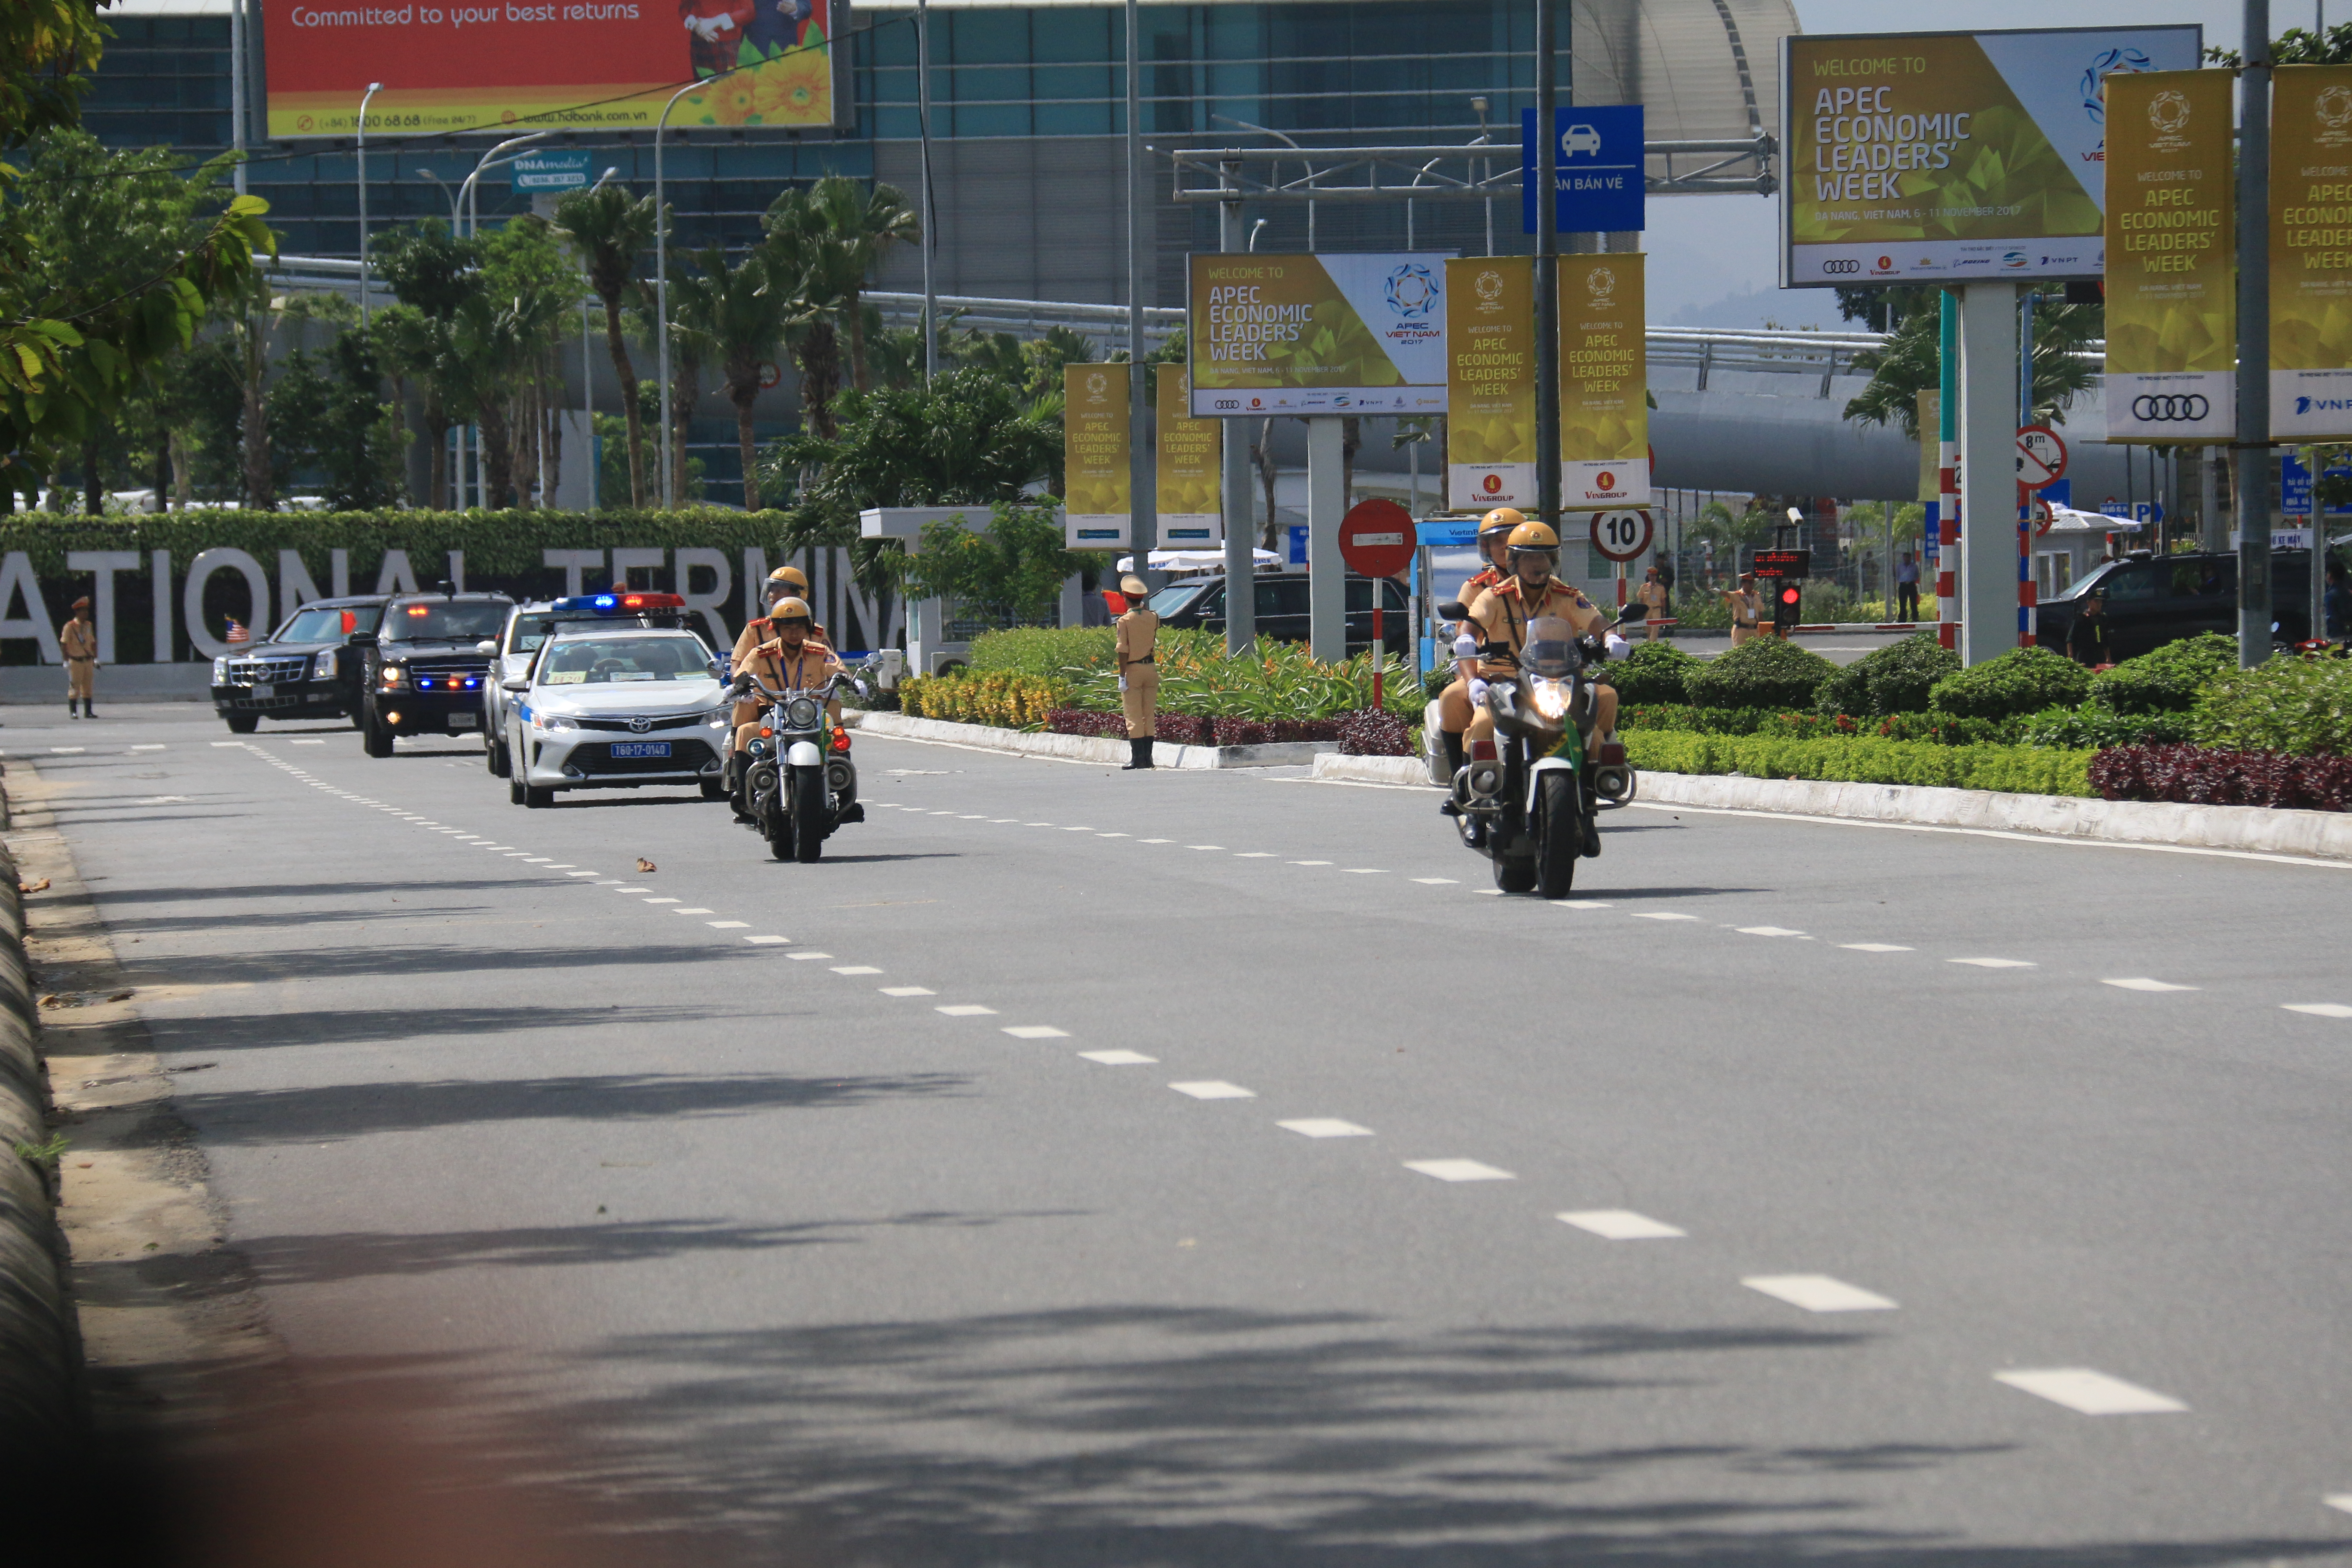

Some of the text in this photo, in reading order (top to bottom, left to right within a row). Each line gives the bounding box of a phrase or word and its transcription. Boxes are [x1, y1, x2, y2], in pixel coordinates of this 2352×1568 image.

[292, 2, 640, 28] Committed to your best returns
[1813, 57, 1926, 76] WELCOME TO
[1814, 86, 1892, 115] APEC
[319, 117, 347, 129] (+84)
[384, 115, 400, 126] 68
[404, 114, 420, 126] 68
[1815, 112, 1970, 144] ECONOMIC
[1815, 141, 1957, 173] LEADERS'
[2081, 152, 2105, 162] VIE
[2138, 170, 2202, 182] WELCOME TO
[2301, 166, 2348, 177] WELCOME
[1574, 174, 1602, 190] BÁN
[1605, 173, 1623, 189] VÉ
[1815, 172, 1901, 202] WEEK
[2145, 188, 2195, 207] APEC
[1831, 211, 1860, 221] NANG,
[1863, 210, 1885, 219] VIET
[1887, 209, 1912, 219] NAM,
[1914, 208, 1920, 217] 6
[1929, 208, 1939, 217] 11
[1942, 206, 1994, 217] NOVEMBER
[1997, 206, 2021, 216] 2017
[2121, 209, 2220, 230] ECONOMIC
[2283, 206, 2352, 226] ECONO
[2125, 230, 2216, 252] LEADERS'
[2142, 254, 2198, 273] WEEK
[1208, 266, 1284, 279] WELCOME TO
[1209, 285, 1261, 304] APEC
[1209, 303, 1313, 324] ECONOMIC
[1210, 323, 1305, 342] LEADERS'
[1468, 325, 1501, 334] WELCOME
[1580, 322, 1612, 330] WELCOME
[1473, 338, 1507, 351] APEC
[1585, 334, 1618, 347] APEC
[1209, 342, 1267, 361] WEEK
[1569, 349, 1635, 363] ECONOMIC
[1457, 352, 1523, 367] ECONOMIC
[1460, 367, 1521, 381] LEADERS'
[1572, 364, 1632, 378] LEADERS'
[1472, 383, 1509, 396] WEEK
[1584, 380, 1621, 393] WEEK
[1085, 422, 1109, 431] APEC
[1176, 422, 1200, 431] APEC
[1072, 432, 1121, 442] ECONOMIC
[1164, 432, 1212, 442] ECONOMIC
[1075, 444, 1119, 453] LEADERS'
[1166, 444, 1210, 453] LEADERS'
[1083, 455, 1111, 465] WEEK
[1174, 455, 1200, 464] WEEK
[1471, 493, 1514, 502] VINGROUP
[1585, 491, 1627, 499] VINGROUP
[1607, 517, 1635, 545] 10
